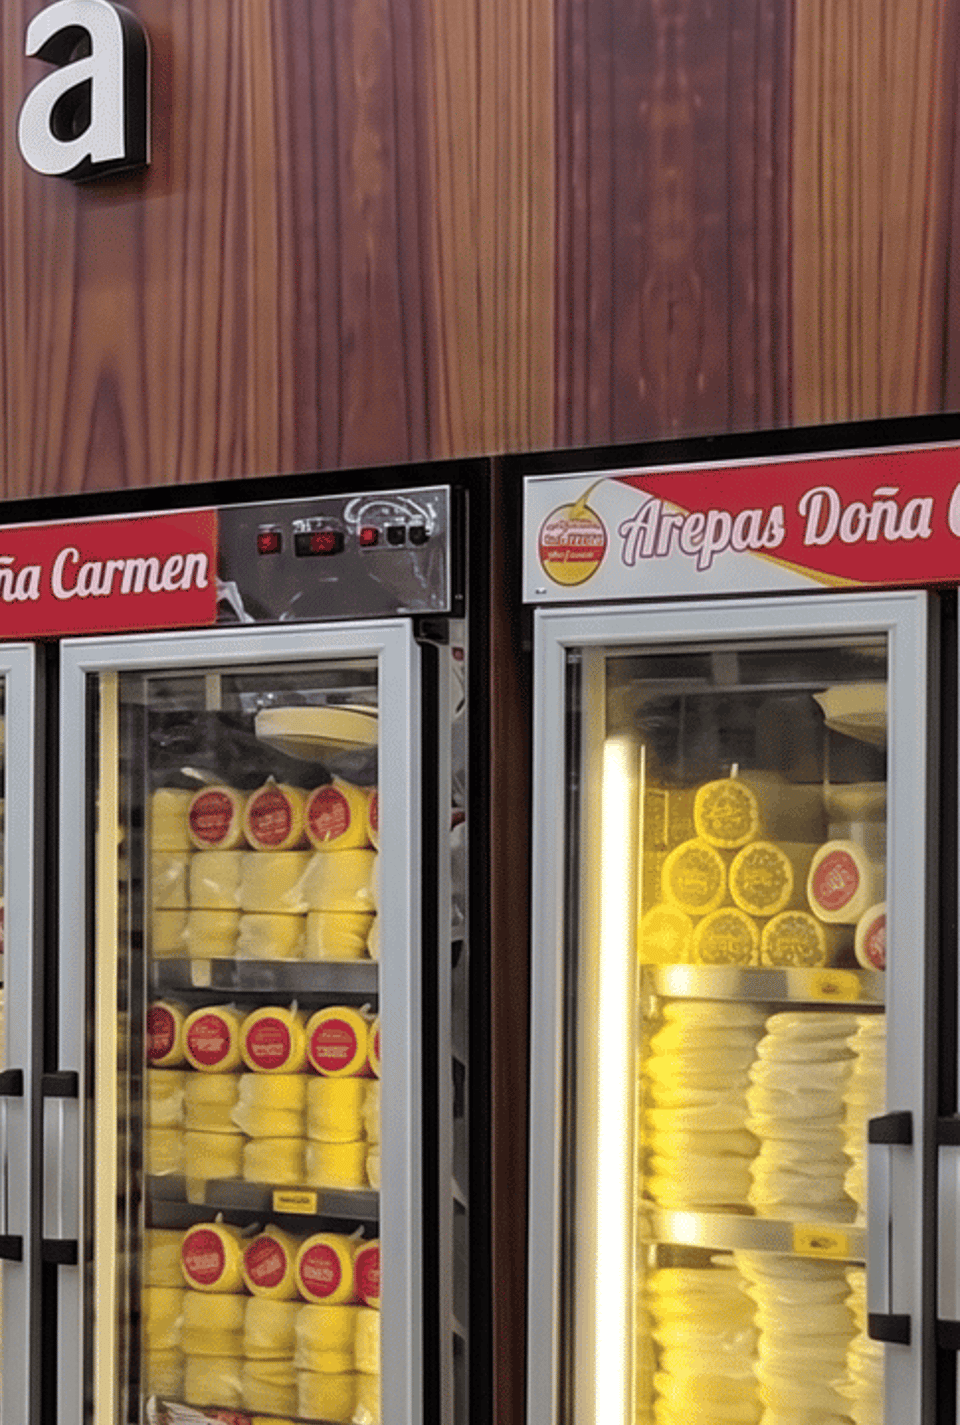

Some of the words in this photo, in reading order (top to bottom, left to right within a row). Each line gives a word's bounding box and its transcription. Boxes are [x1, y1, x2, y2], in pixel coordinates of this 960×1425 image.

[618, 496, 786, 571] Arepas
[798, 485, 934, 546] Doña
[51, 547, 208, 600] Carmen
